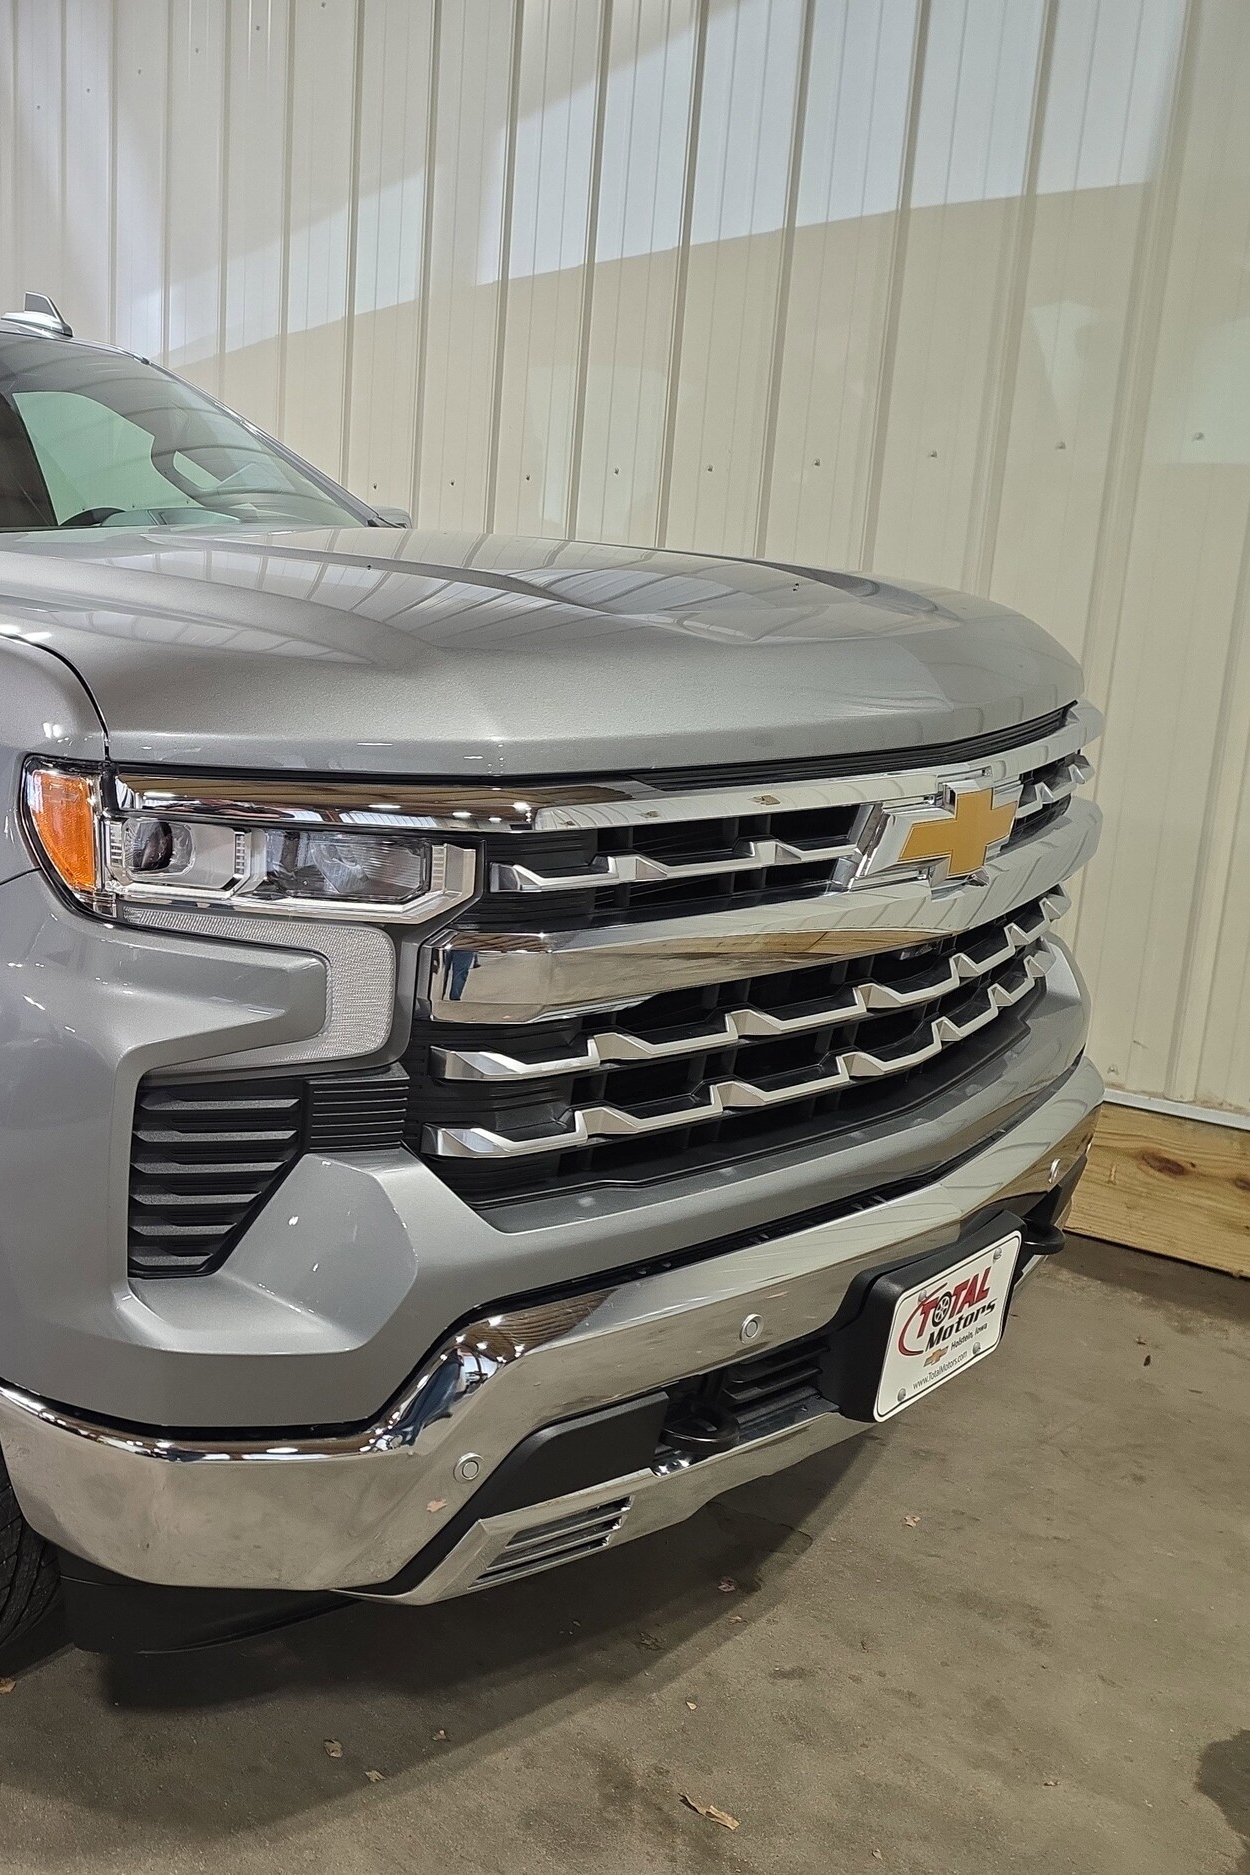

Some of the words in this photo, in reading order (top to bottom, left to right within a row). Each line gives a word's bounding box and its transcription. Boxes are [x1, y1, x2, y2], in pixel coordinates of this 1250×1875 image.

[916, 1266, 992, 1339] TOTAL
[925, 1299, 997, 1351] Motors
[975, 1322, 988, 1340] Iowa
[913, 1350, 968, 1390] www.TotalMotors.com
